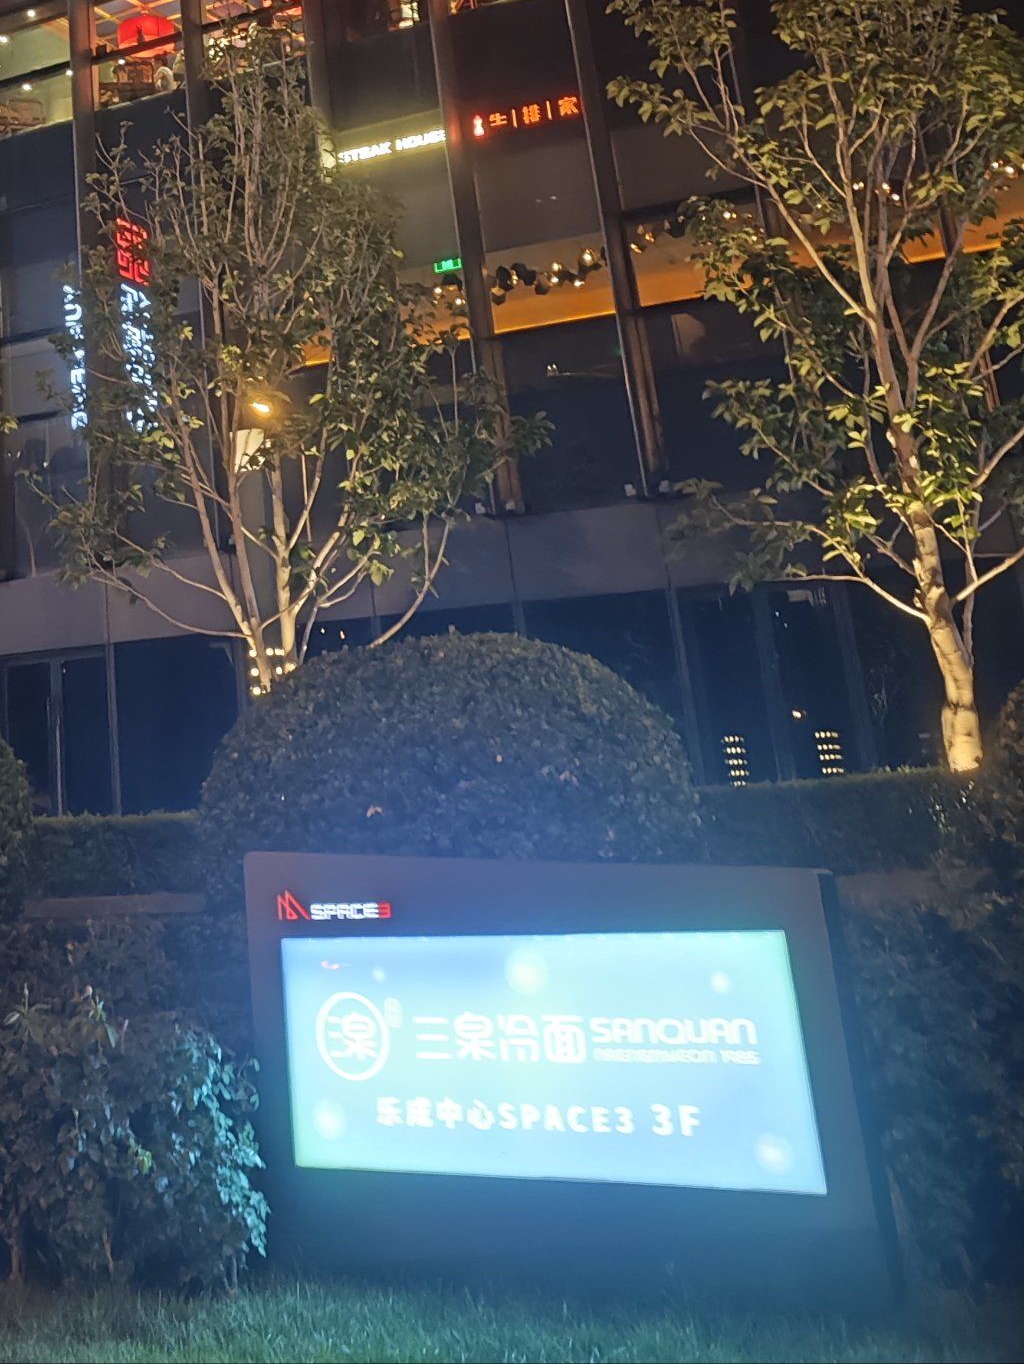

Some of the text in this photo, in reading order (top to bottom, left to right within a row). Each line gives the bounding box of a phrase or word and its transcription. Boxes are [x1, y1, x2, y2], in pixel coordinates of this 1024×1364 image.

[310, 901, 391, 920] SPACE3
[412, 1011, 587, 1064] 三泉冷面
[650, 1103, 701, 1137] 3F
